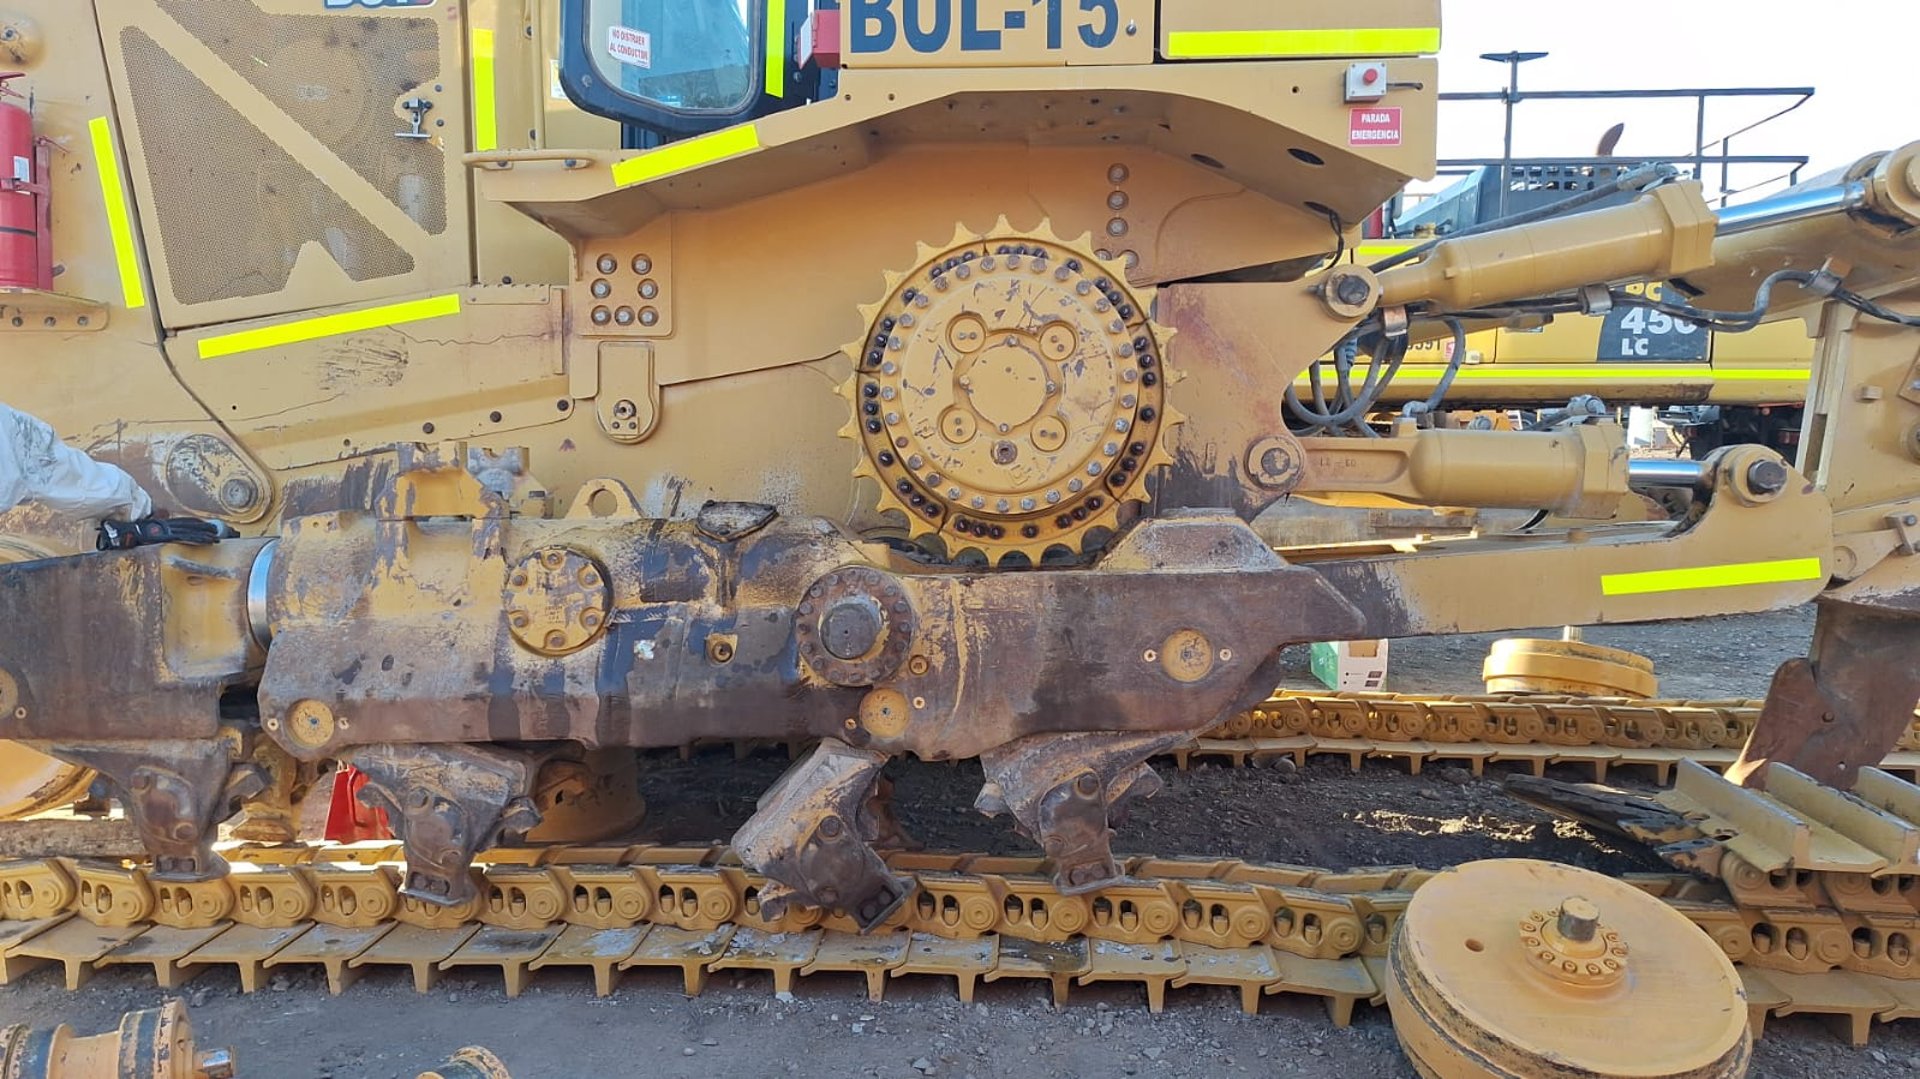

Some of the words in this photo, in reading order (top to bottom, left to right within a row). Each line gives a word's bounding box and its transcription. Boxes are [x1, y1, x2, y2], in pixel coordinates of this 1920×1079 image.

[850, 0, 1120, 53] BUL-15
[1361, 113, 1391, 123] PARADA
[1352, 129, 1399, 140] EMERGENCIA
[1621, 338, 1649, 355] LC
